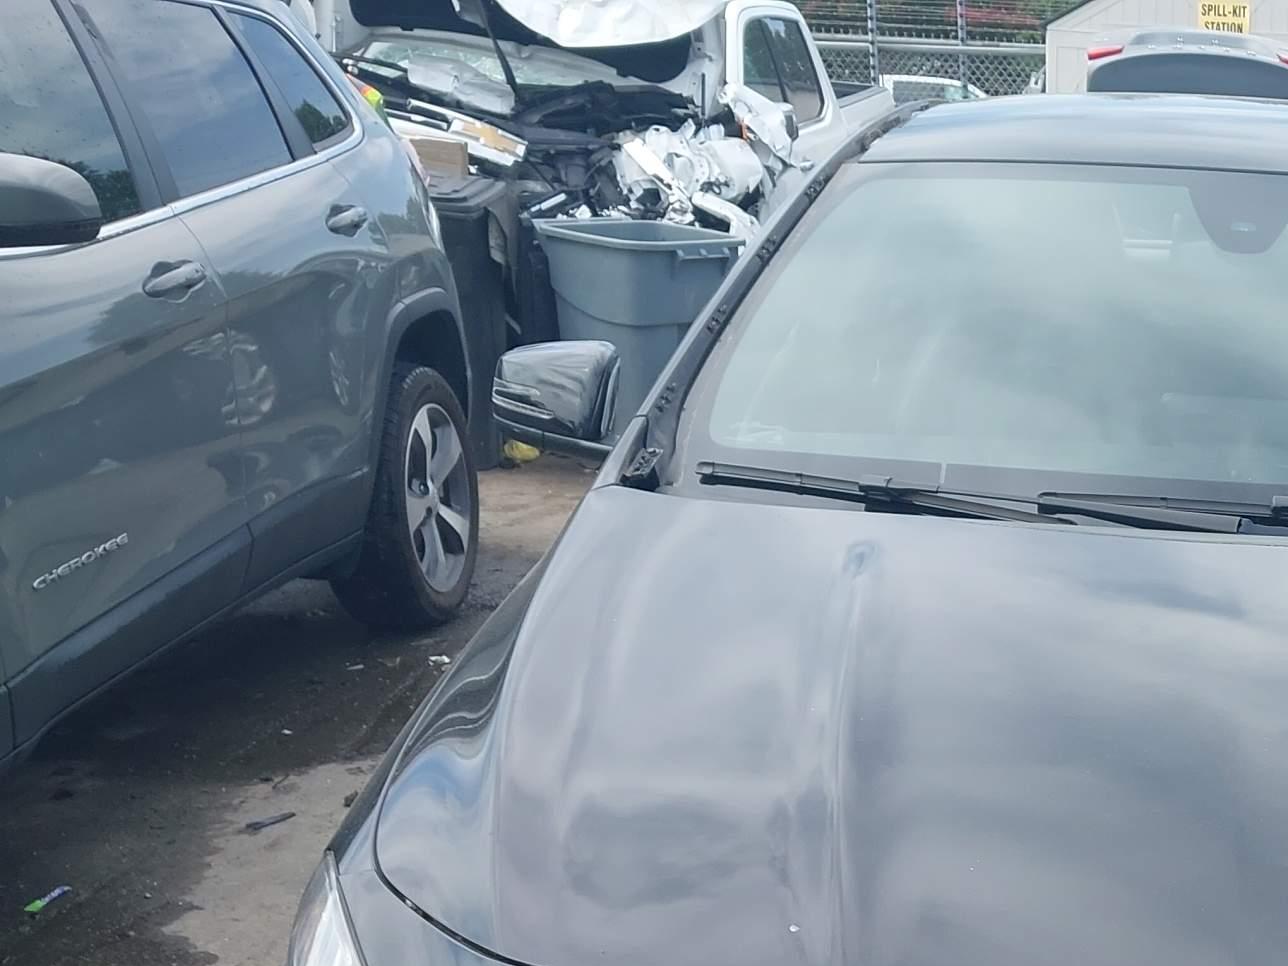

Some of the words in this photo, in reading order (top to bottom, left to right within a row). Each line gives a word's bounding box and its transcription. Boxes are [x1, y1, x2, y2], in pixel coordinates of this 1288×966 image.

[1201, 3, 1247, 18] SPILL-KIT
[1204, 20, 1243, 33] STATION
[32, 532, 129, 589] CHEROKEE
